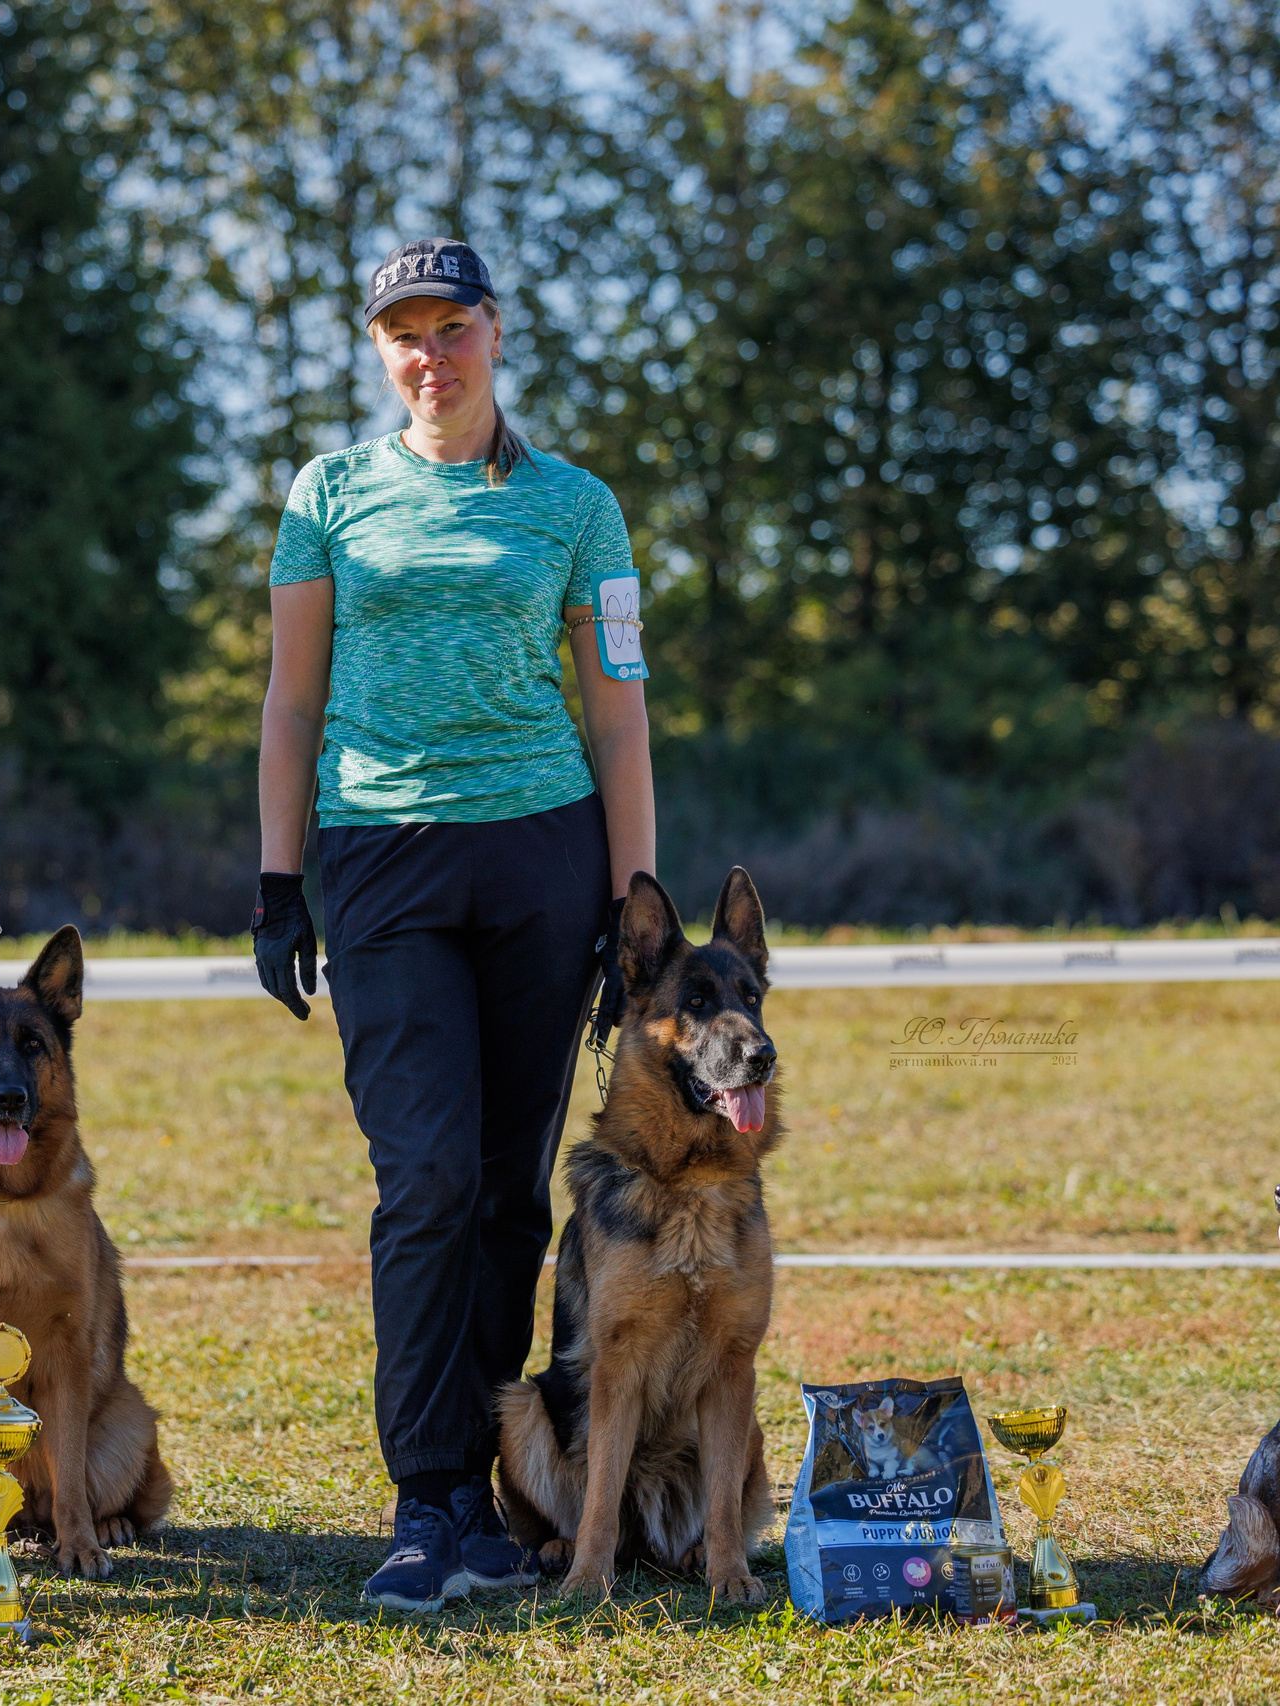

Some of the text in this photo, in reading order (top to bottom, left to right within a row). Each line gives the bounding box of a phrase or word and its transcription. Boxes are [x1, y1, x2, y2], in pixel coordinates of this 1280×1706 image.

[375, 253, 460, 296] STYLE
[846, 1487, 953, 1508] BUFFALO
[898, 1509, 923, 1517] Quality
[923, 1508, 942, 1516] Food
[862, 1525, 958, 1540] PUPPY & JUNIOR
[974, 1561, 1001, 1569] BUFFALO
